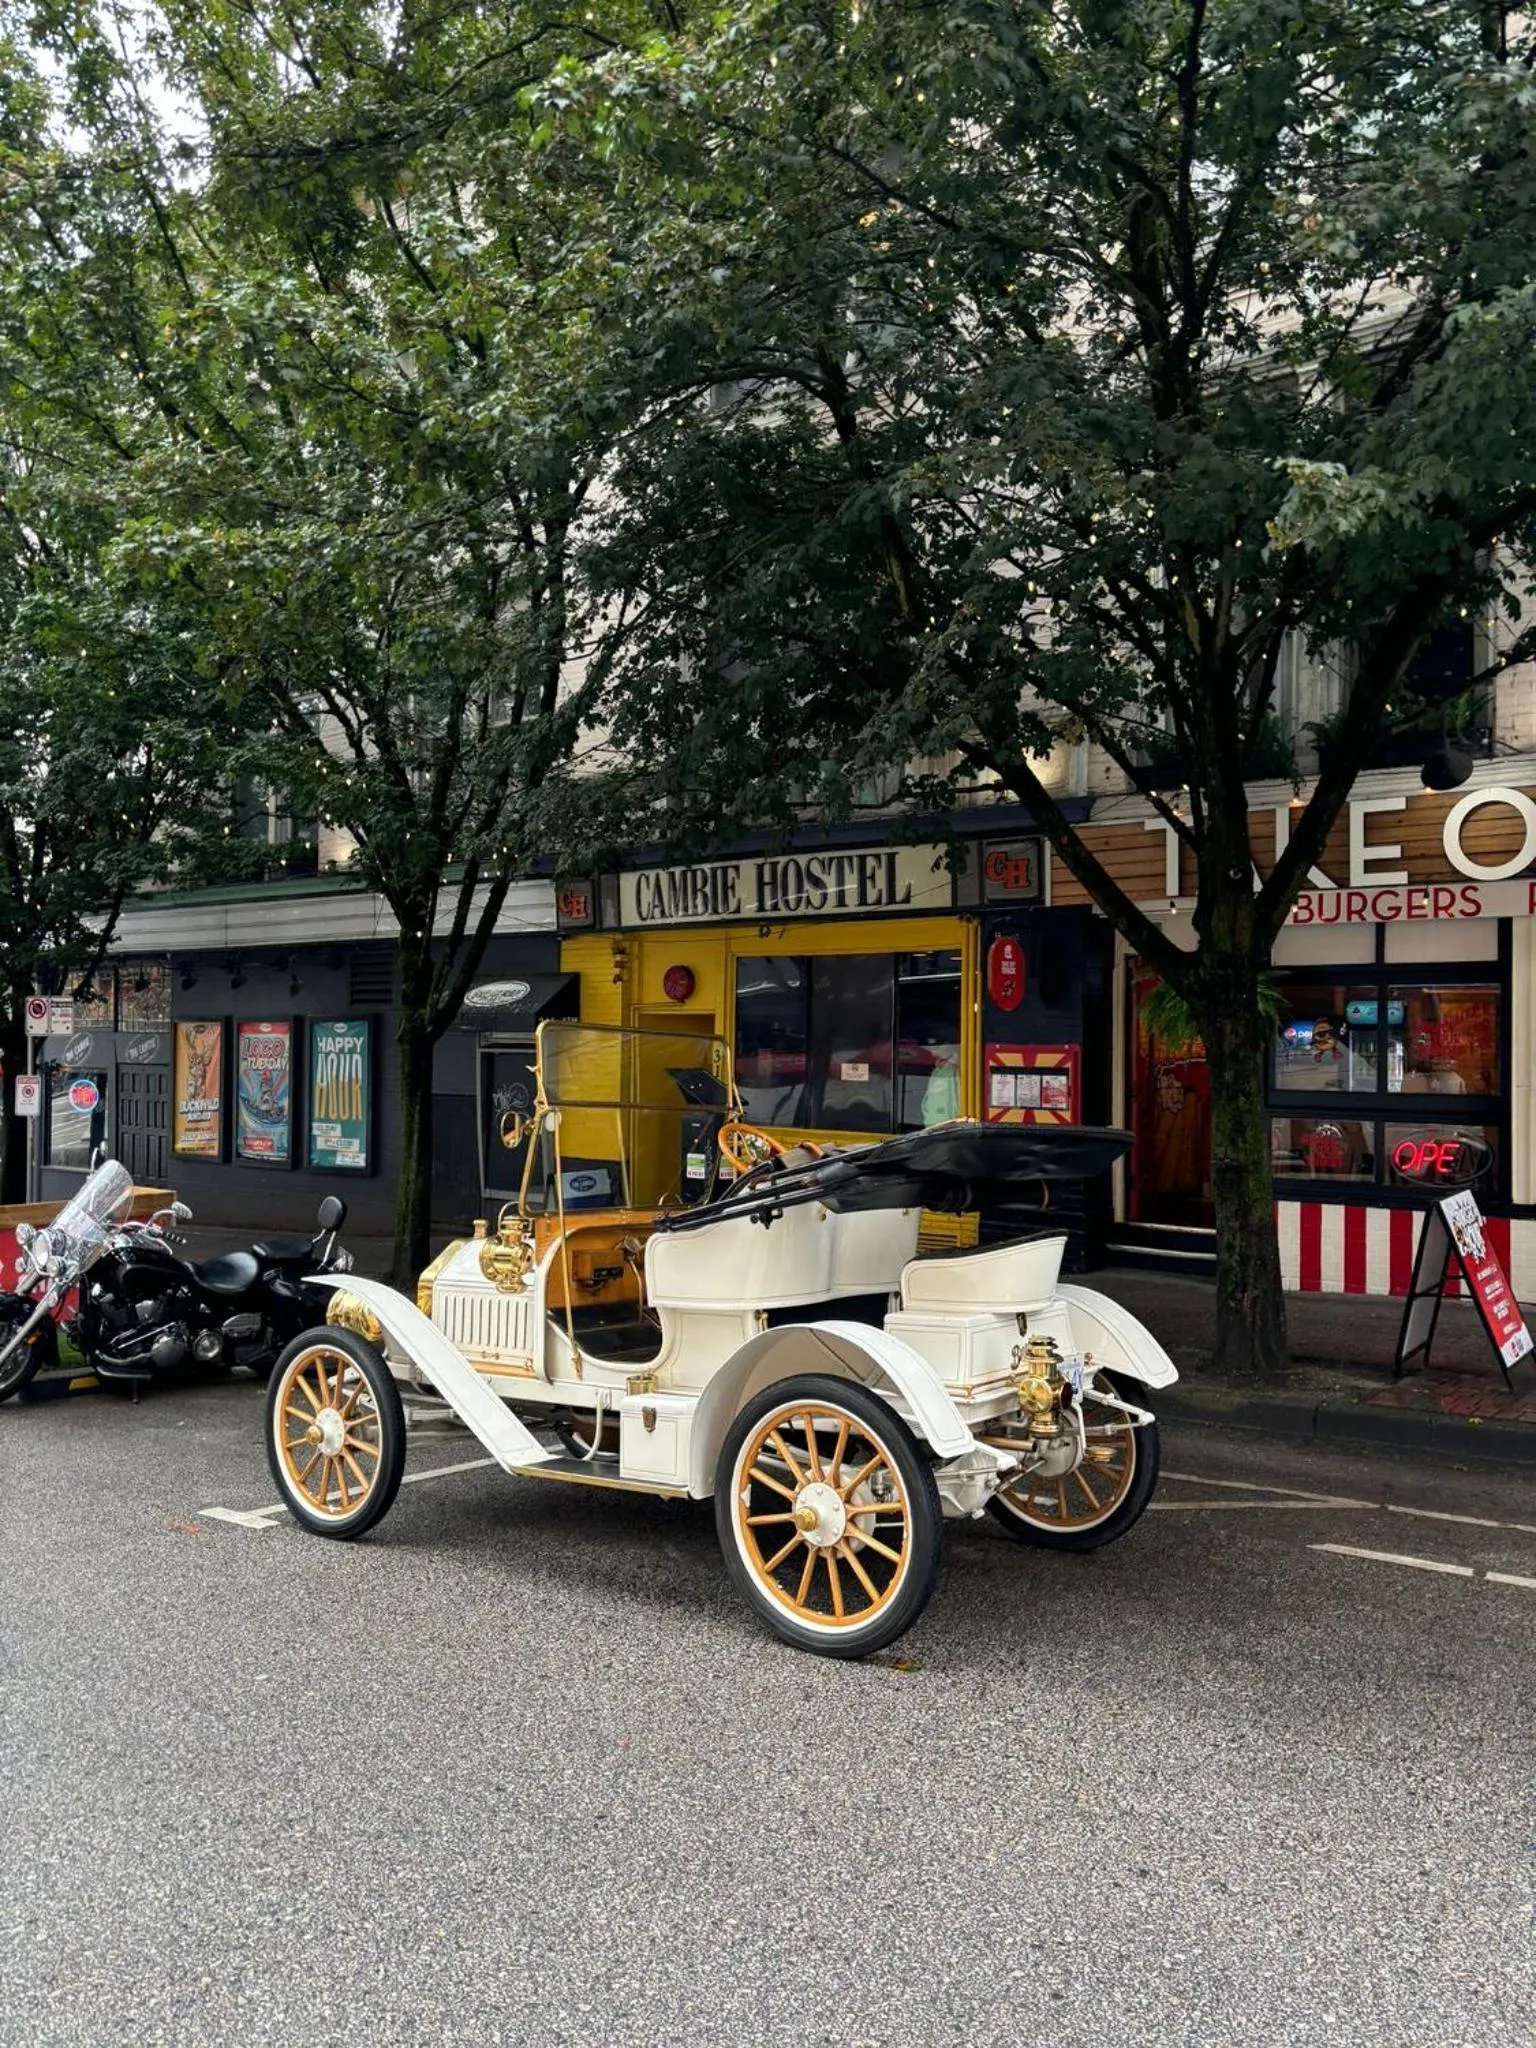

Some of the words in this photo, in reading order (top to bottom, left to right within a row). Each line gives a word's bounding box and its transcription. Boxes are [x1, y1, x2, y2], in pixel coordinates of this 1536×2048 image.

[1144, 796, 1408, 897] TKE
[635, 864, 742, 922] CAMBIE
[753, 851, 912, 913] HOSTEL
[1292, 885, 1482, 924] BURGERS
[241, 1036, 285, 1059] LOCO
[247, 1056, 289, 1071] TUESDAY
[317, 1036, 364, 1054] HAPPY
[314, 1052, 362, 1120] HOUR
